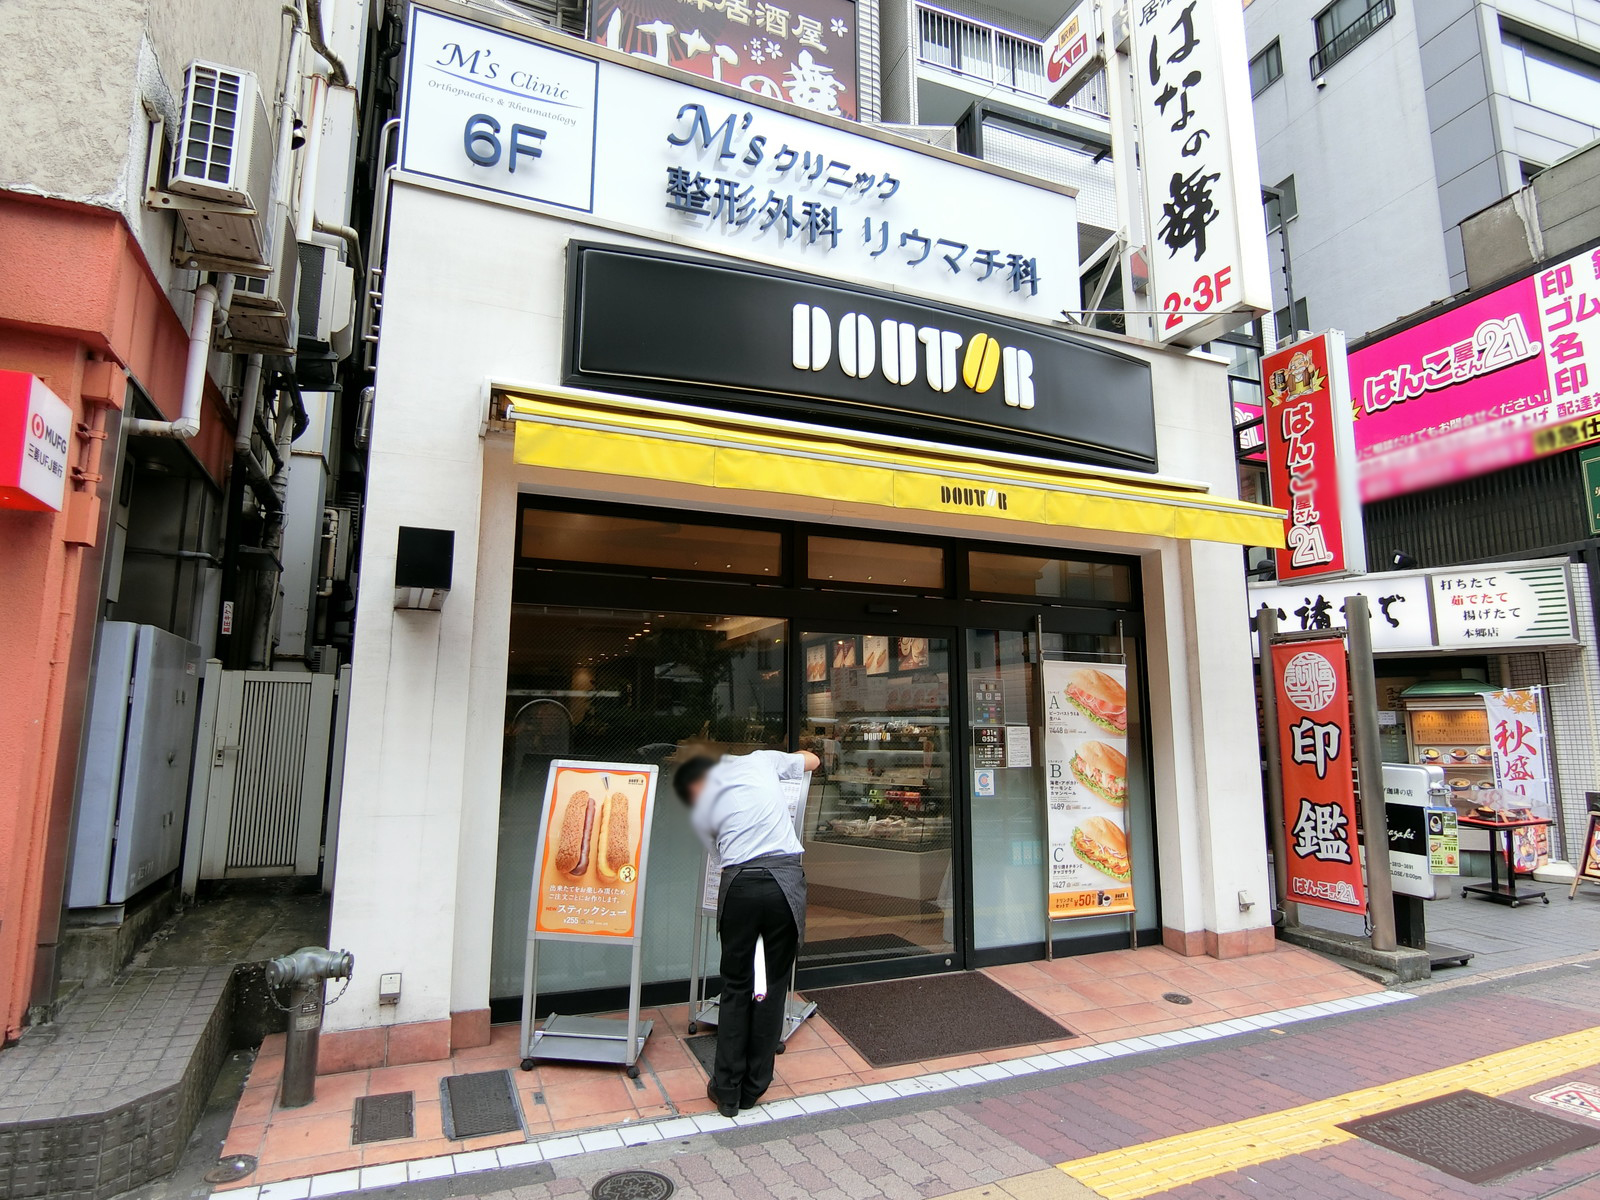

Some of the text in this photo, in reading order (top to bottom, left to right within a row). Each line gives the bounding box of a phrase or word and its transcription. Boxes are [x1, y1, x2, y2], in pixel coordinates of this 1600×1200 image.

[436, 43, 570, 100] M's Clinic
[428, 79, 577, 126] Orthopaedics & Rheumatology
[464, 113, 548, 174] 6F
[667, 103, 900, 201] M's クリニック
[665, 166, 1042, 297] 整形外科 リウマチ科
[792, 303, 1035, 410] DOUTOR
[45, 425, 67, 454] MUFG
[941, 485, 1008, 510] DOUTOR
[1440, 576, 1497, 590] 打ちたて
[1451, 592, 1508, 606] 茹でたて
[1463, 607, 1520, 621] 揚げたて
[1464, 627, 1499, 638] 本郷店
[1049, 695, 1060, 709] A
[864, 733, 891, 741] DOUTOR
[1494, 719, 1537, 796] 秋盛り
[1050, 764, 1062, 778] B
[1291, 718, 1352, 863] 印鑑
[1054, 847, 1064, 862] C
[557, 904, 627, 916] スティックシュー
